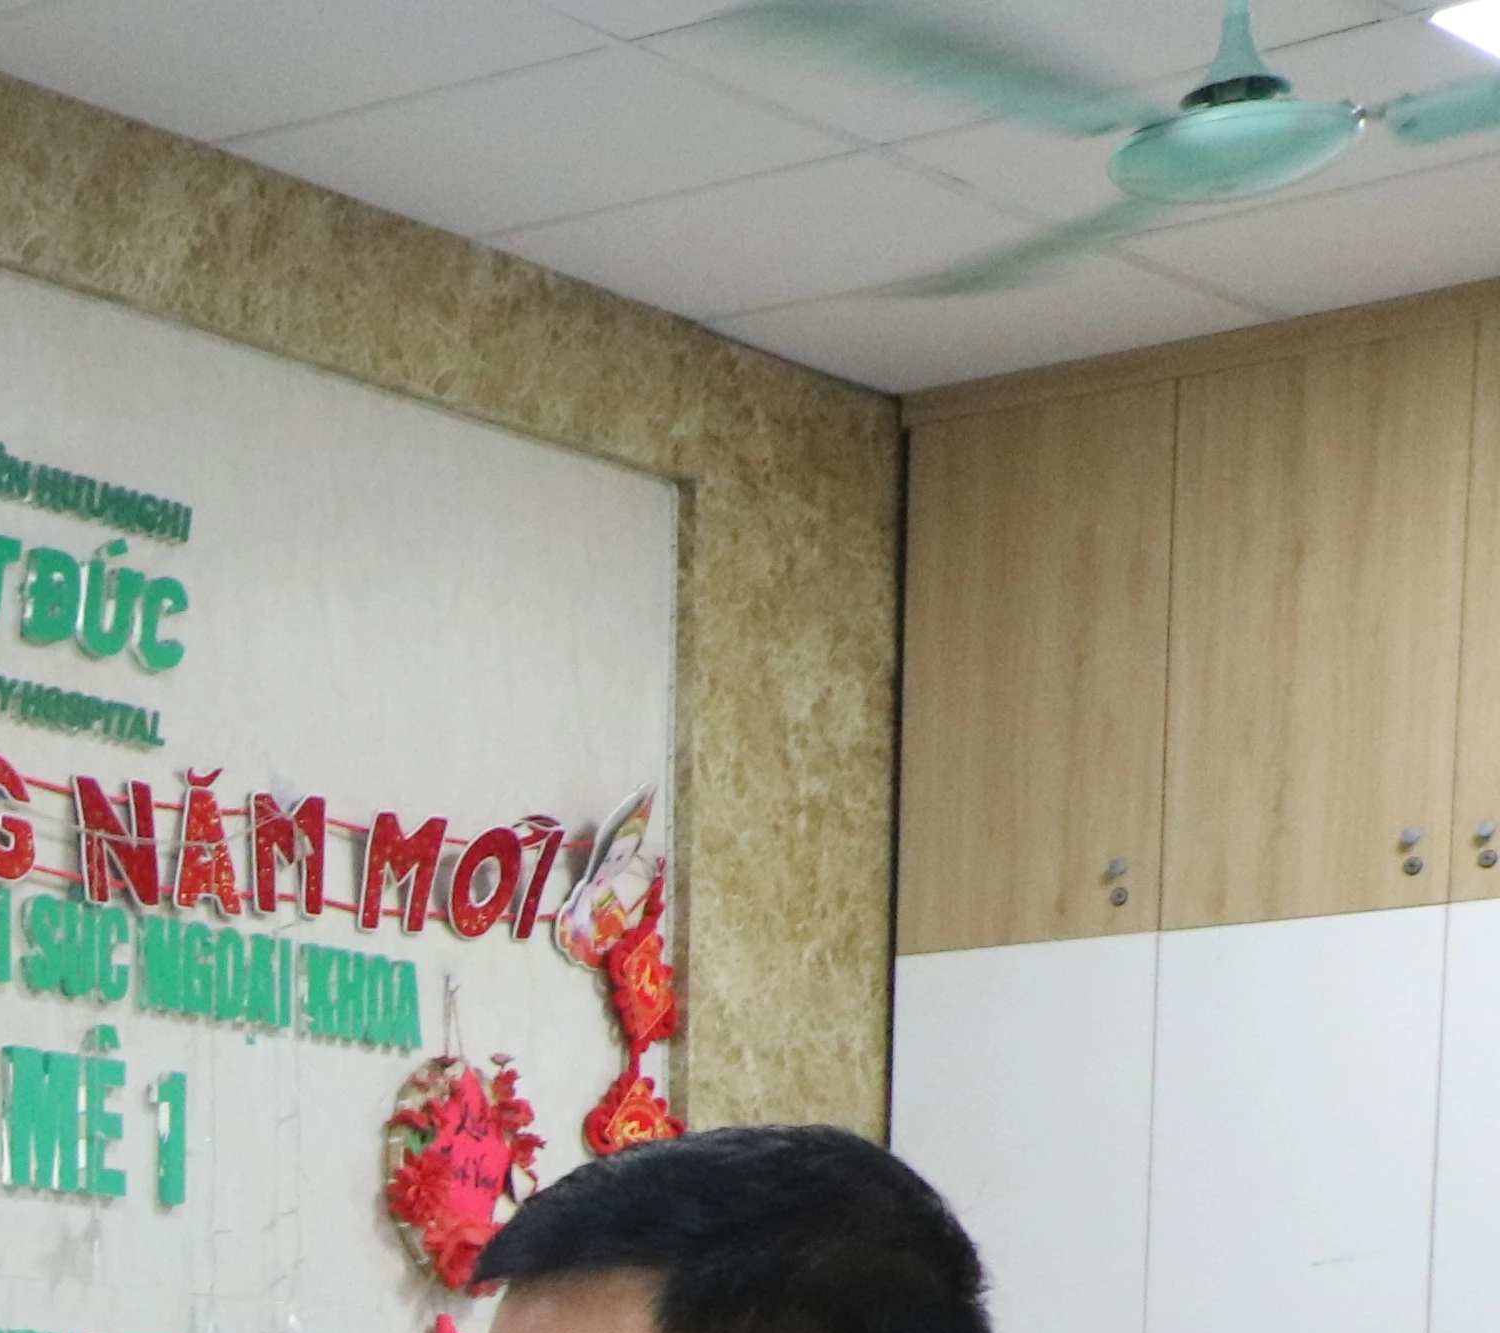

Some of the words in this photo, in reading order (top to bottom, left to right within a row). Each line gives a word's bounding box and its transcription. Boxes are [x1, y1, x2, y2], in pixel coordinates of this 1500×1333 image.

[18, 538, 190, 675] ĐỨC
[72, 766, 328, 916] NĂM
[298, 943, 423, 1050] KHOA
[2, 1024, 127, 1197] MÊ
[150, 1072, 187, 1204] 1
